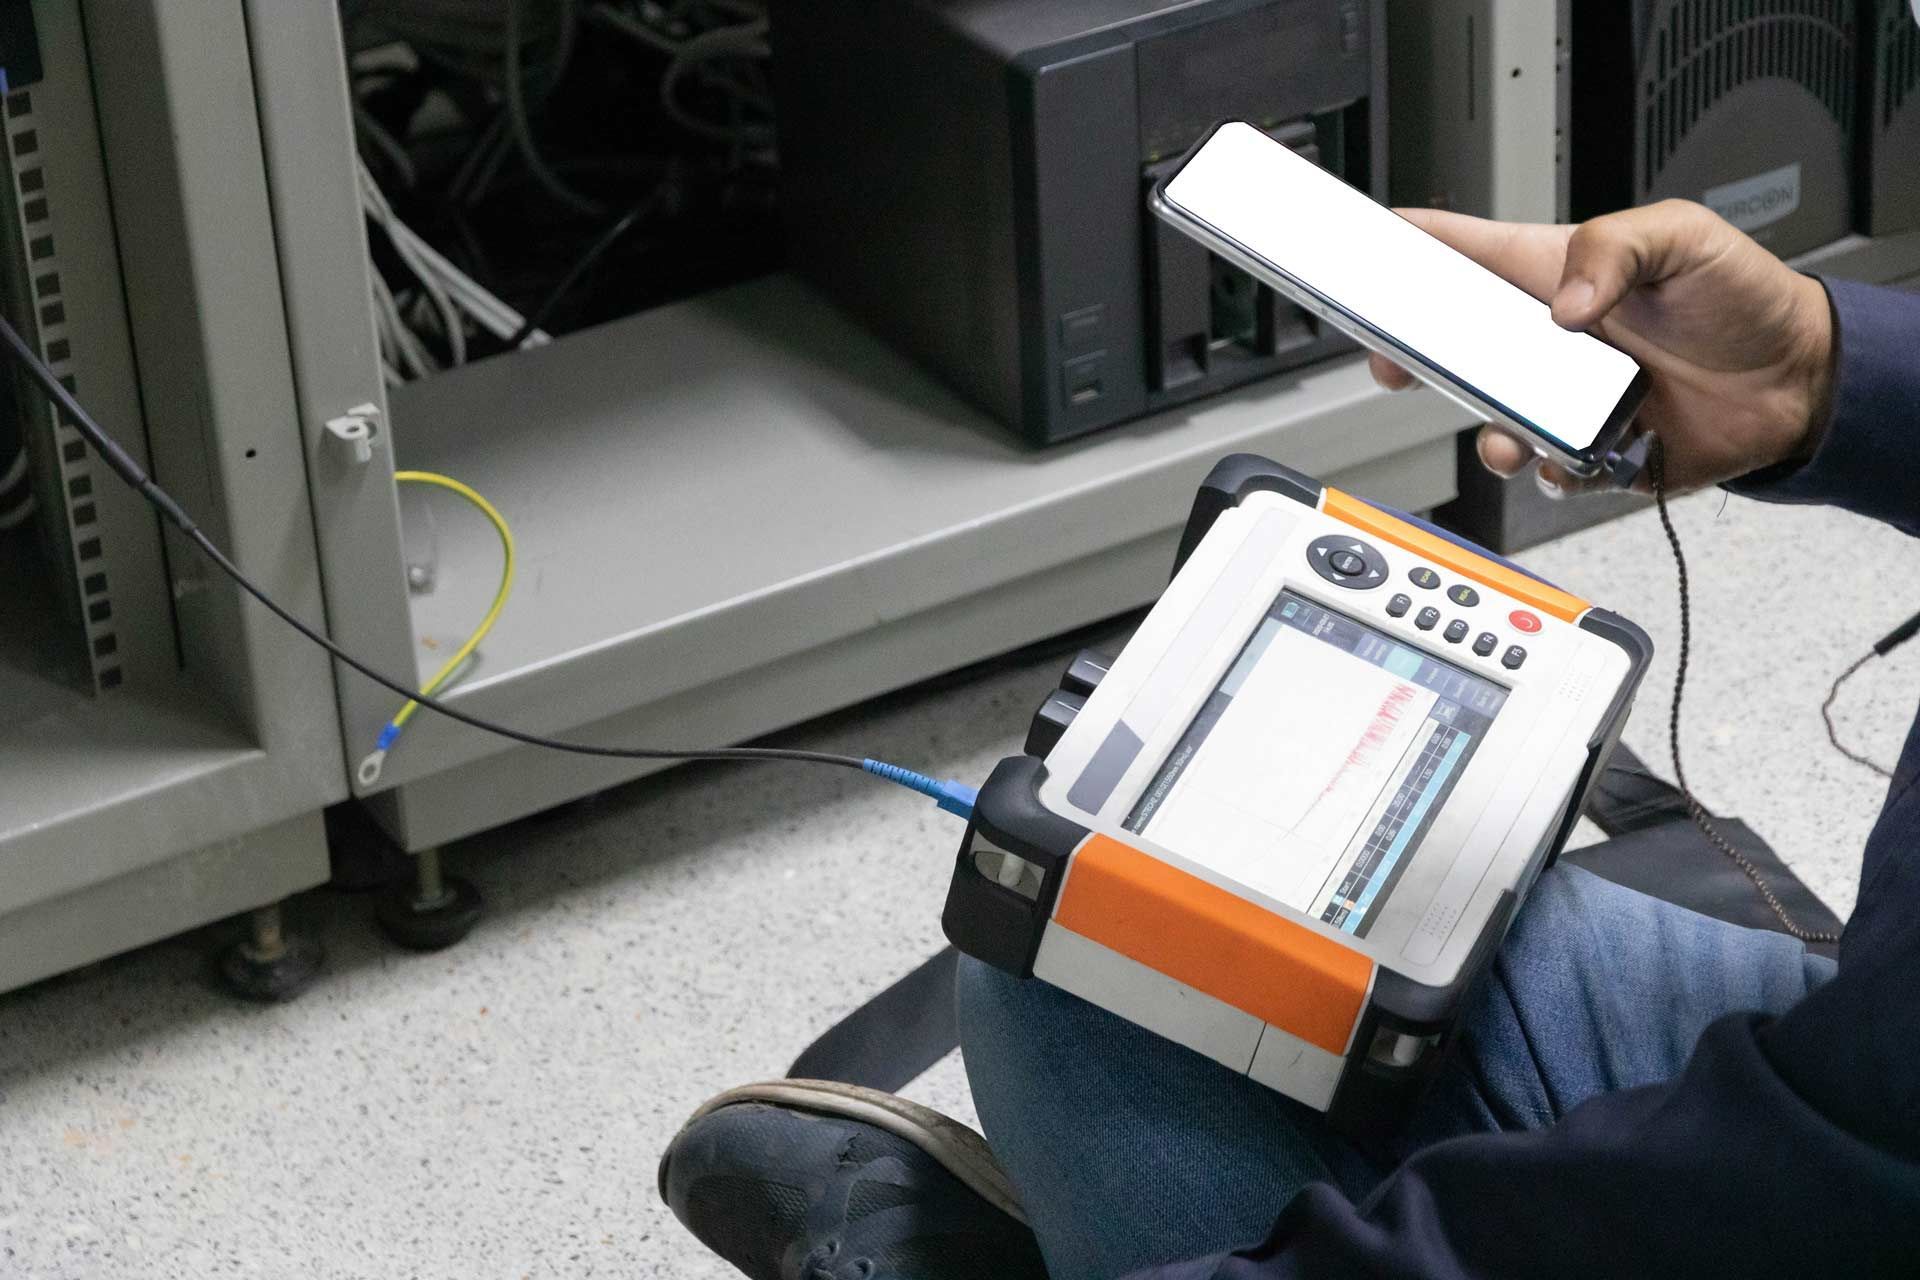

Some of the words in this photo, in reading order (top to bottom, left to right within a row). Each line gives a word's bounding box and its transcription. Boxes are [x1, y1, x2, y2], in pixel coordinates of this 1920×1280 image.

[1421, 570, 1432, 584] SCAN
[1458, 588, 1472, 601] REAL
[1396, 596, 1409, 605] F1
[1425, 609, 1437, 618] F2
[1454, 621, 1465, 630] F3
[1483, 634, 1495, 643] F4
[1511, 647, 1523, 657] F5
